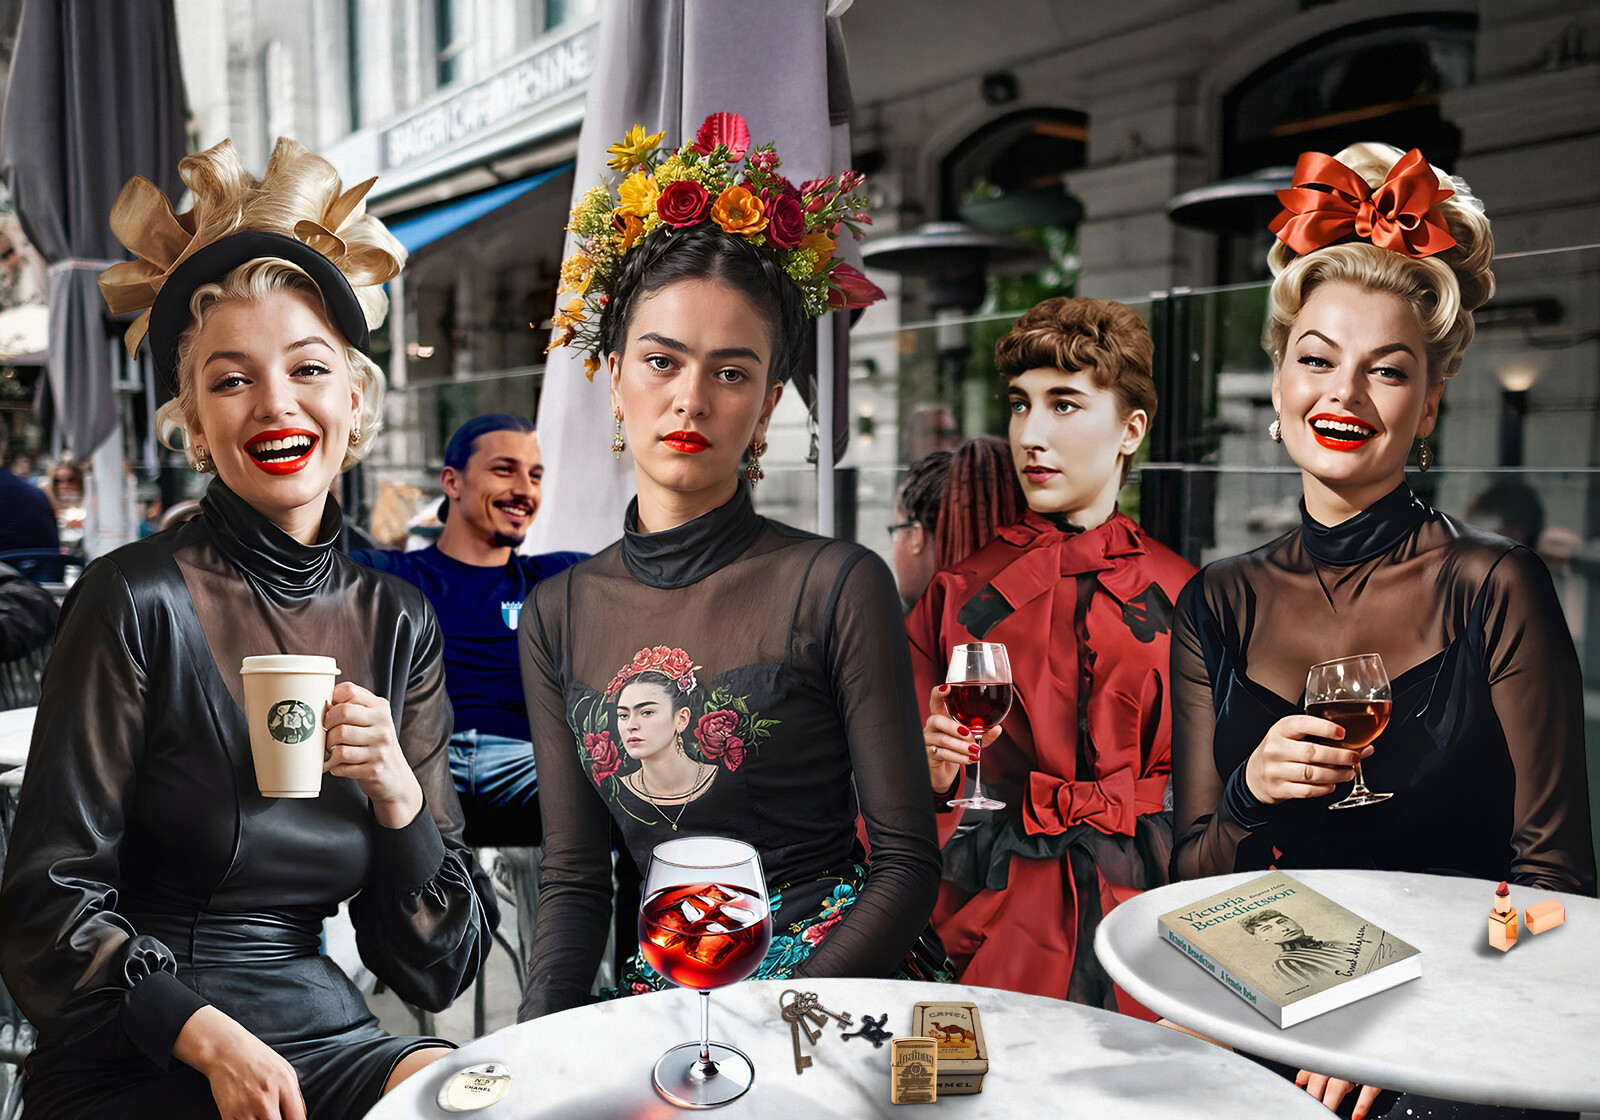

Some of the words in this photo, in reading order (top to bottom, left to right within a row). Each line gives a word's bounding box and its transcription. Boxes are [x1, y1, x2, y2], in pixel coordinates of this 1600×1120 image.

[1179, 896, 1247, 922] Victoria
[1190, 888, 1297, 931] Benedictsson
[1220, 970, 1225, 980] A
[928, 1011, 968, 1020] CAMEL
